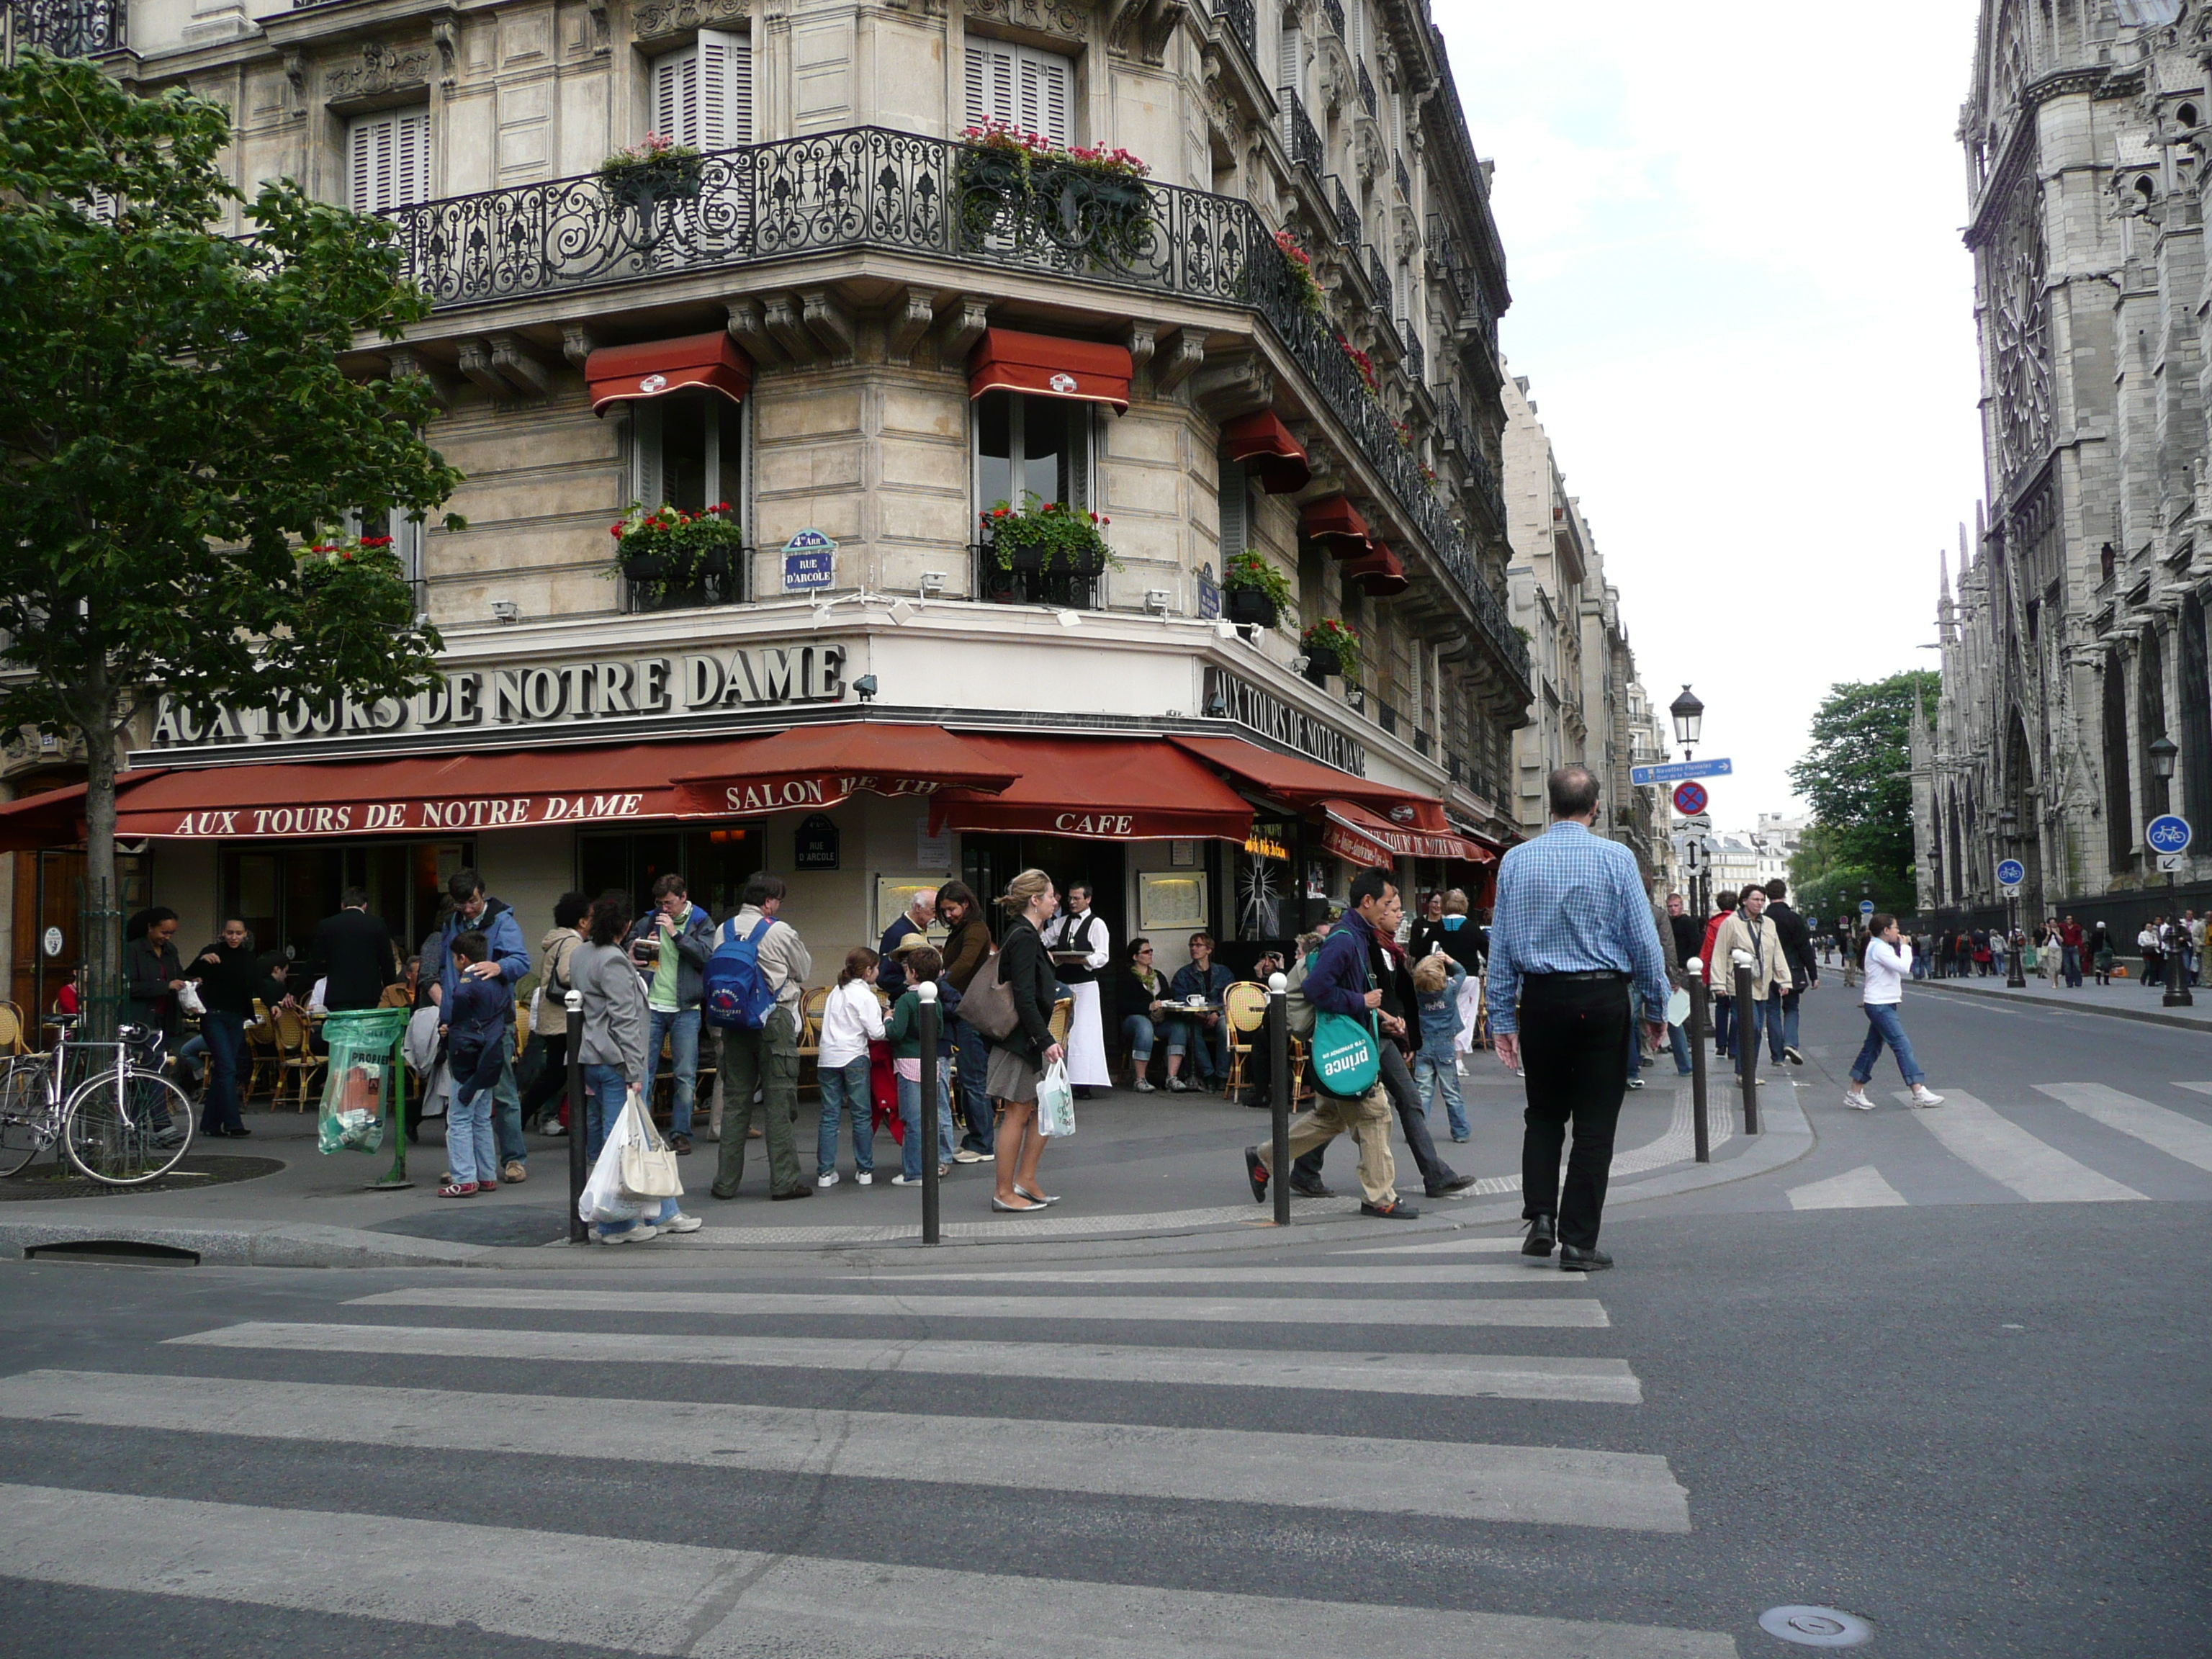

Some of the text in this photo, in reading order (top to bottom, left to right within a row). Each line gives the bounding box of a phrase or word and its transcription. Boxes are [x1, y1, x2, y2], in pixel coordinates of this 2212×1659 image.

[799, 559, 818, 569] RUE
[786, 572, 831, 584] D'ARCOLE
[415, 673, 481, 724] DE
[493, 658, 670, 720] NOTRE
[683, 645, 847, 708] DAME
[1244, 684, 1286, 743] TOURS
[1290, 708, 1305, 750] DE
[1306, 717, 1341, 768] NOTRE
[1341, 736, 1367, 781] DAME
[727, 779, 824, 811] SALON
[895, 778, 940, 793] TH
[174, 793, 644, 835] AUX TOURS DE NOTRE DAME
[1055, 813, 1133, 835] CAFE
[809, 841, 824, 850] RUE
[1385, 833, 1411, 853] TOURS
[1424, 837, 1448, 855] NOTRE
[1324, 1046, 1369, 1076] prince
